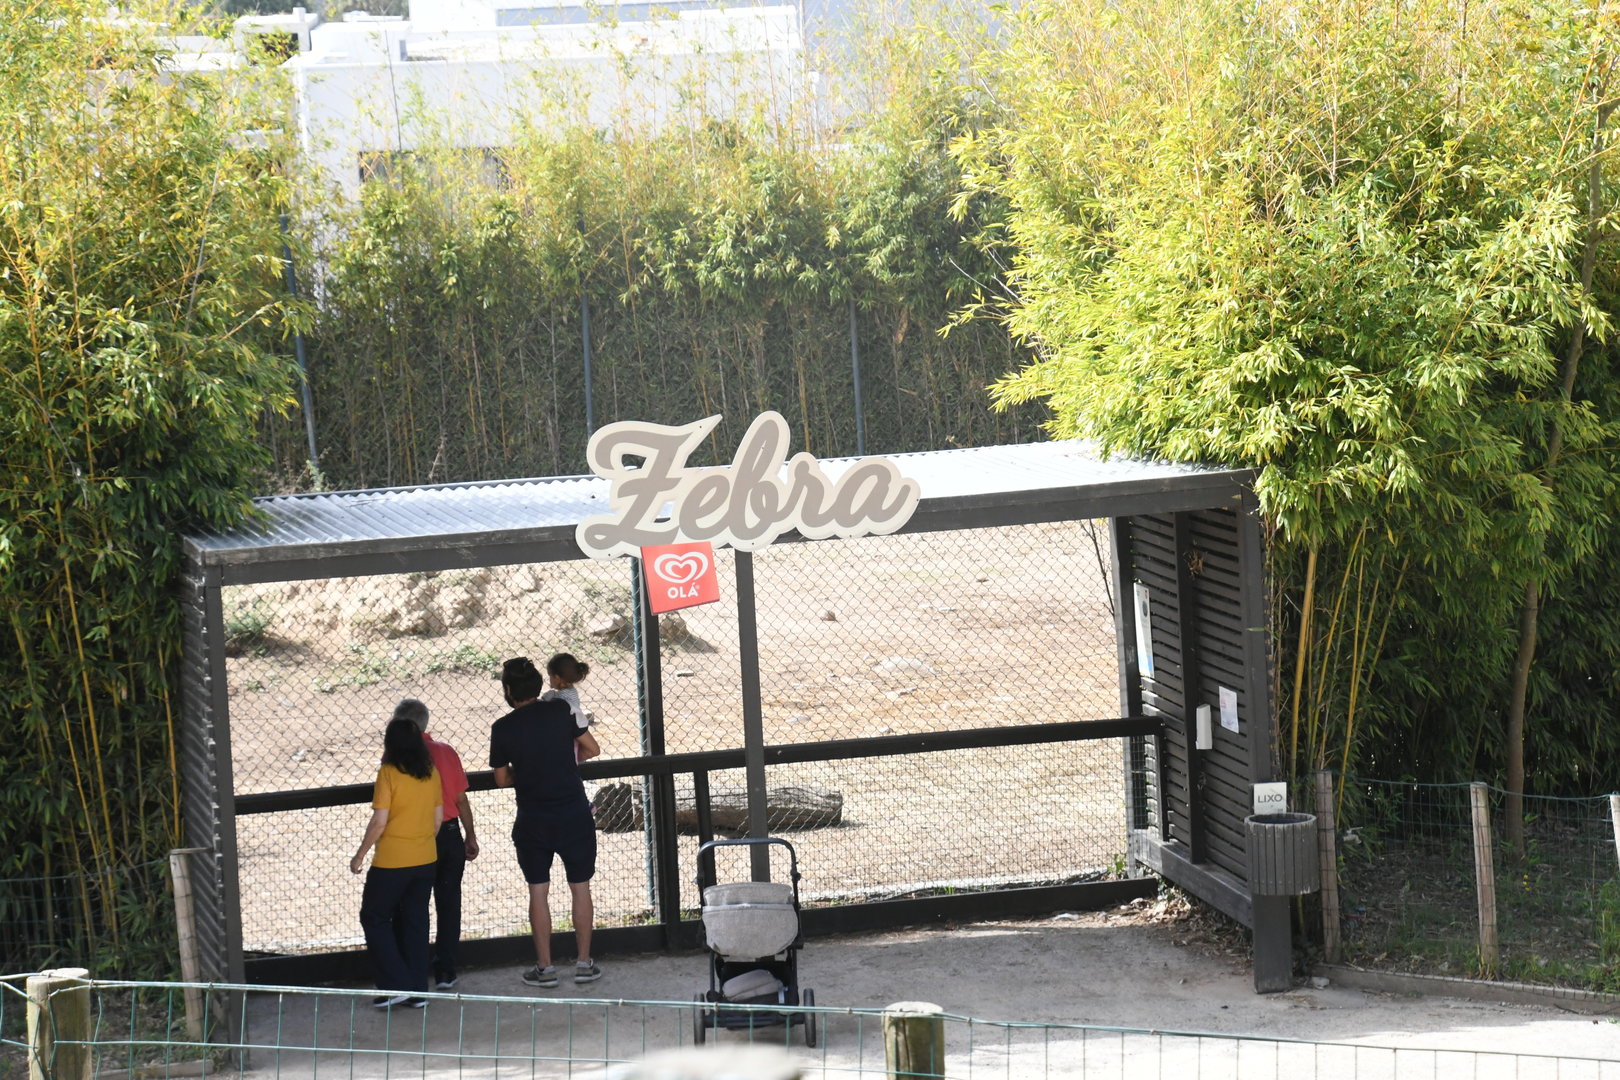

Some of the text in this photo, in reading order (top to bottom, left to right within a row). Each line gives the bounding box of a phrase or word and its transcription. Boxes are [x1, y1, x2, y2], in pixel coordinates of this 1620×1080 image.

[582, 417, 912, 551] Zebra
[667, 582, 698, 599] OLÁ
[1257, 793, 1283, 804] LIXO
